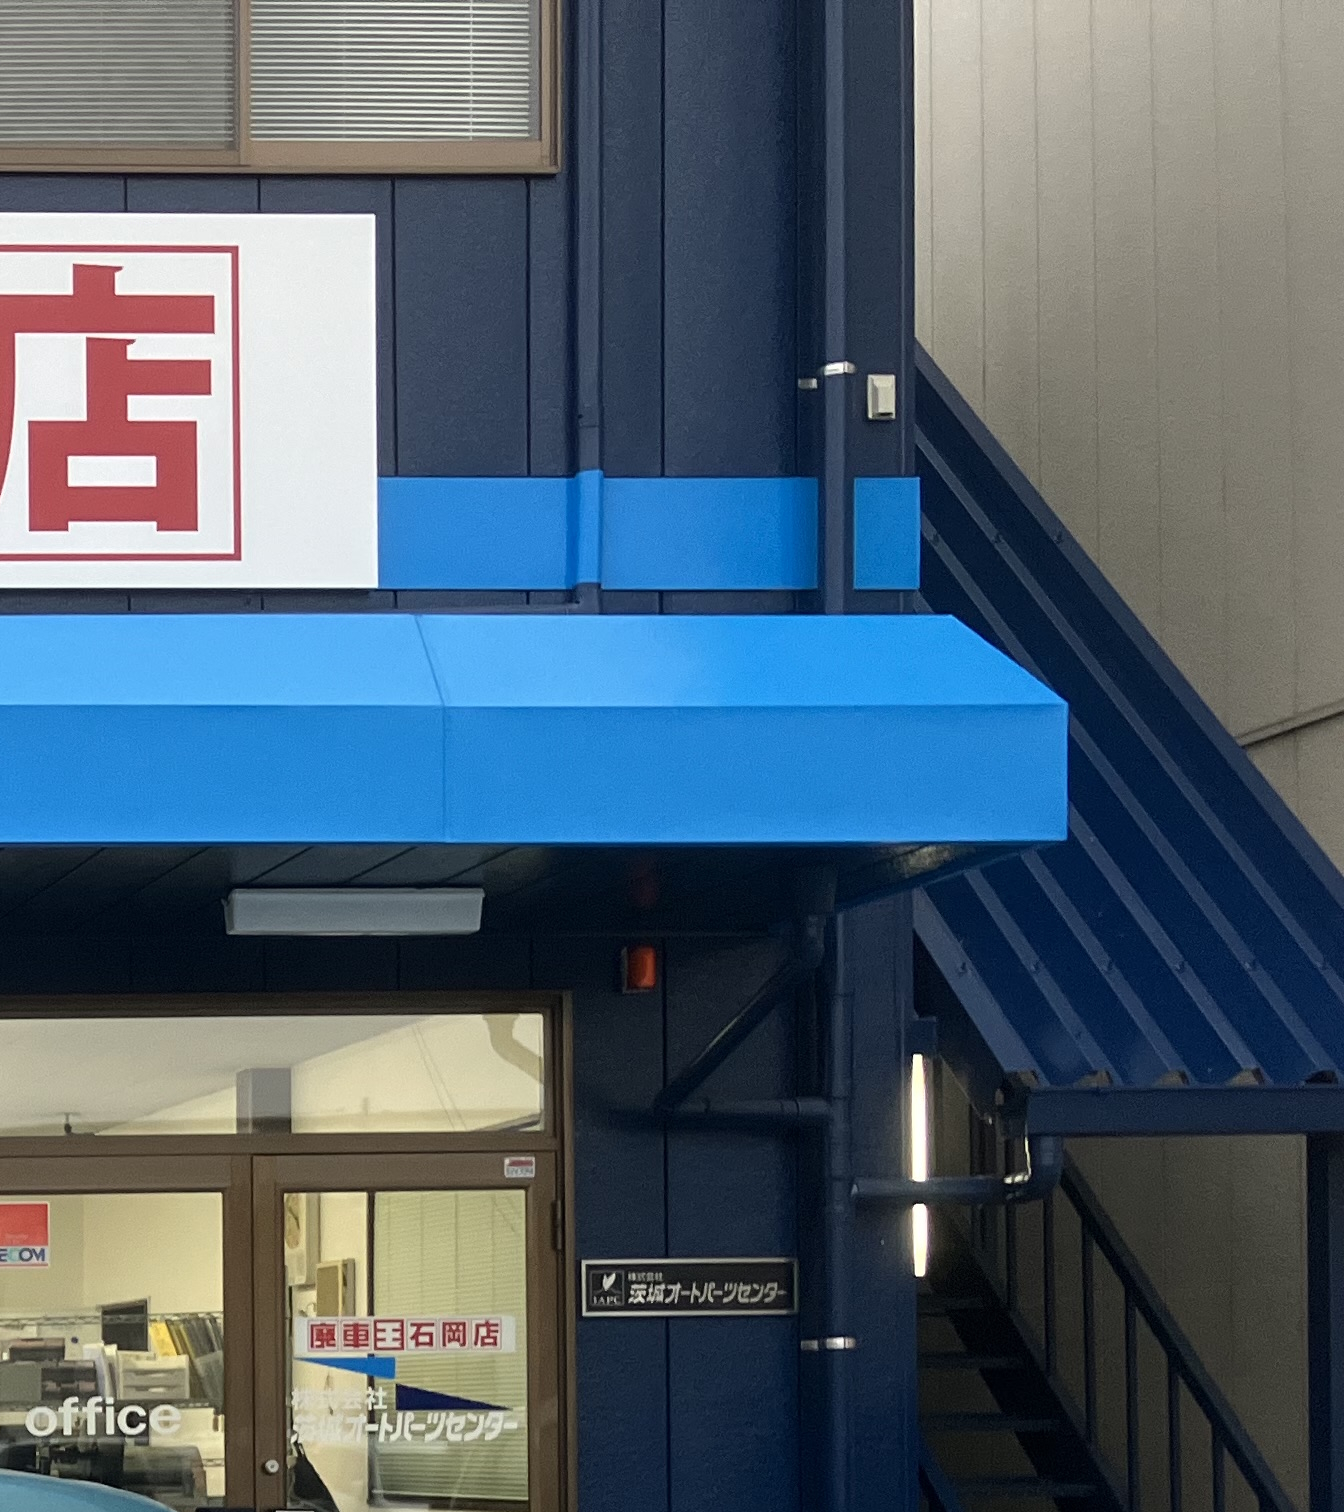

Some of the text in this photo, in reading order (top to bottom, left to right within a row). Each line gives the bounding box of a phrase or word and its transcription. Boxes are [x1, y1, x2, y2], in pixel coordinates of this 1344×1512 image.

[628, 1281, 787, 1305] 茨城オートパーツセンター
[309, 1317, 500, 1351] 廃車王石岡店
[25, 1396, 182, 1437] office
